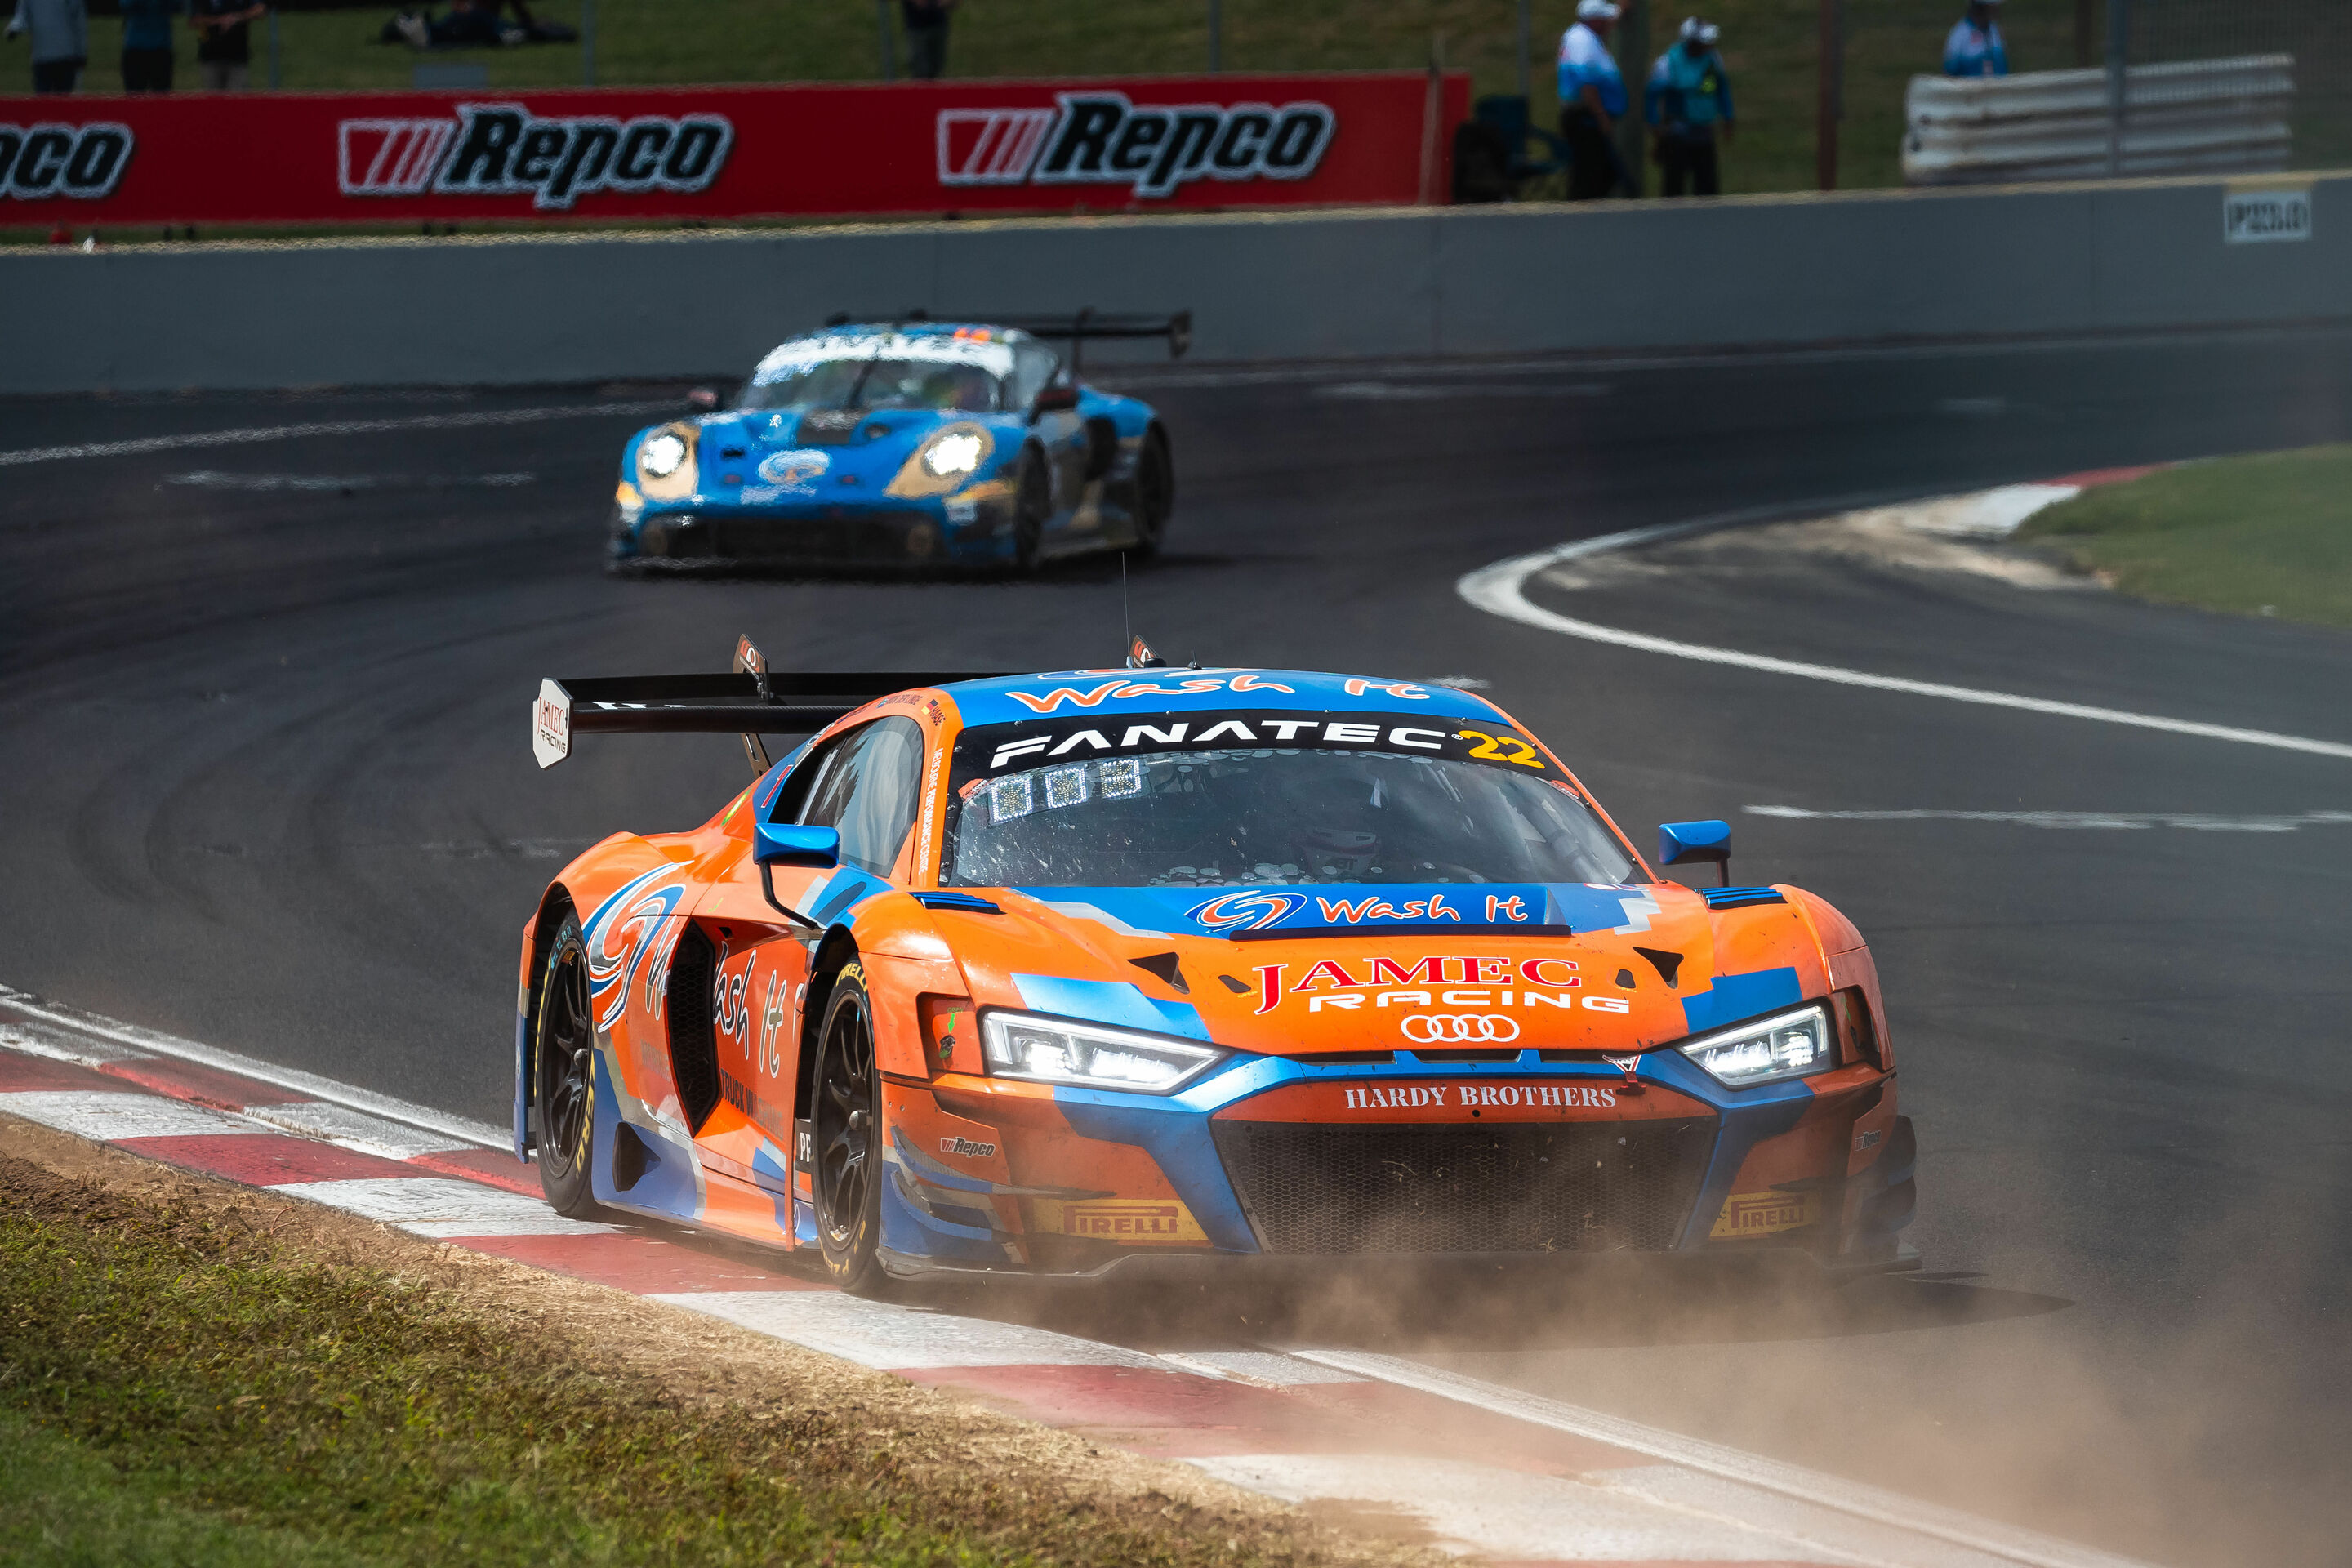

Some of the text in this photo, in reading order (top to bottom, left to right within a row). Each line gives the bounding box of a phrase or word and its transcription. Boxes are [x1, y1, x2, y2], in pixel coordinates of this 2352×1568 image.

[433, 104, 733, 209] Repco
[1031, 91, 1336, 198] Repco
[1005, 675, 1431, 713] Wash It
[537, 697, 564, 736] JAMEC
[929, 707, 947, 727] HAASE
[540, 728, 566, 754] RACING
[990, 719, 1446, 769] FANATEC
[1458, 730, 1546, 769] 22
[918, 747, 944, 876] MELBOURNE PERFORMANCE CENTRE
[1315, 894, 1528, 924] Wash It
[1252, 956, 1582, 1015] JAMEC
[1309, 990, 1630, 1014] RACING
[760, 969, 786, 1079] It
[720, 1068, 745, 1113] TRUCK
[1345, 1086, 1616, 1109] HARDY BROTHERS
[953, 1136, 996, 1158] Repco
[1063, 1205, 1178, 1234] PIRELLI
[1731, 1195, 1805, 1229] PIRELLI
